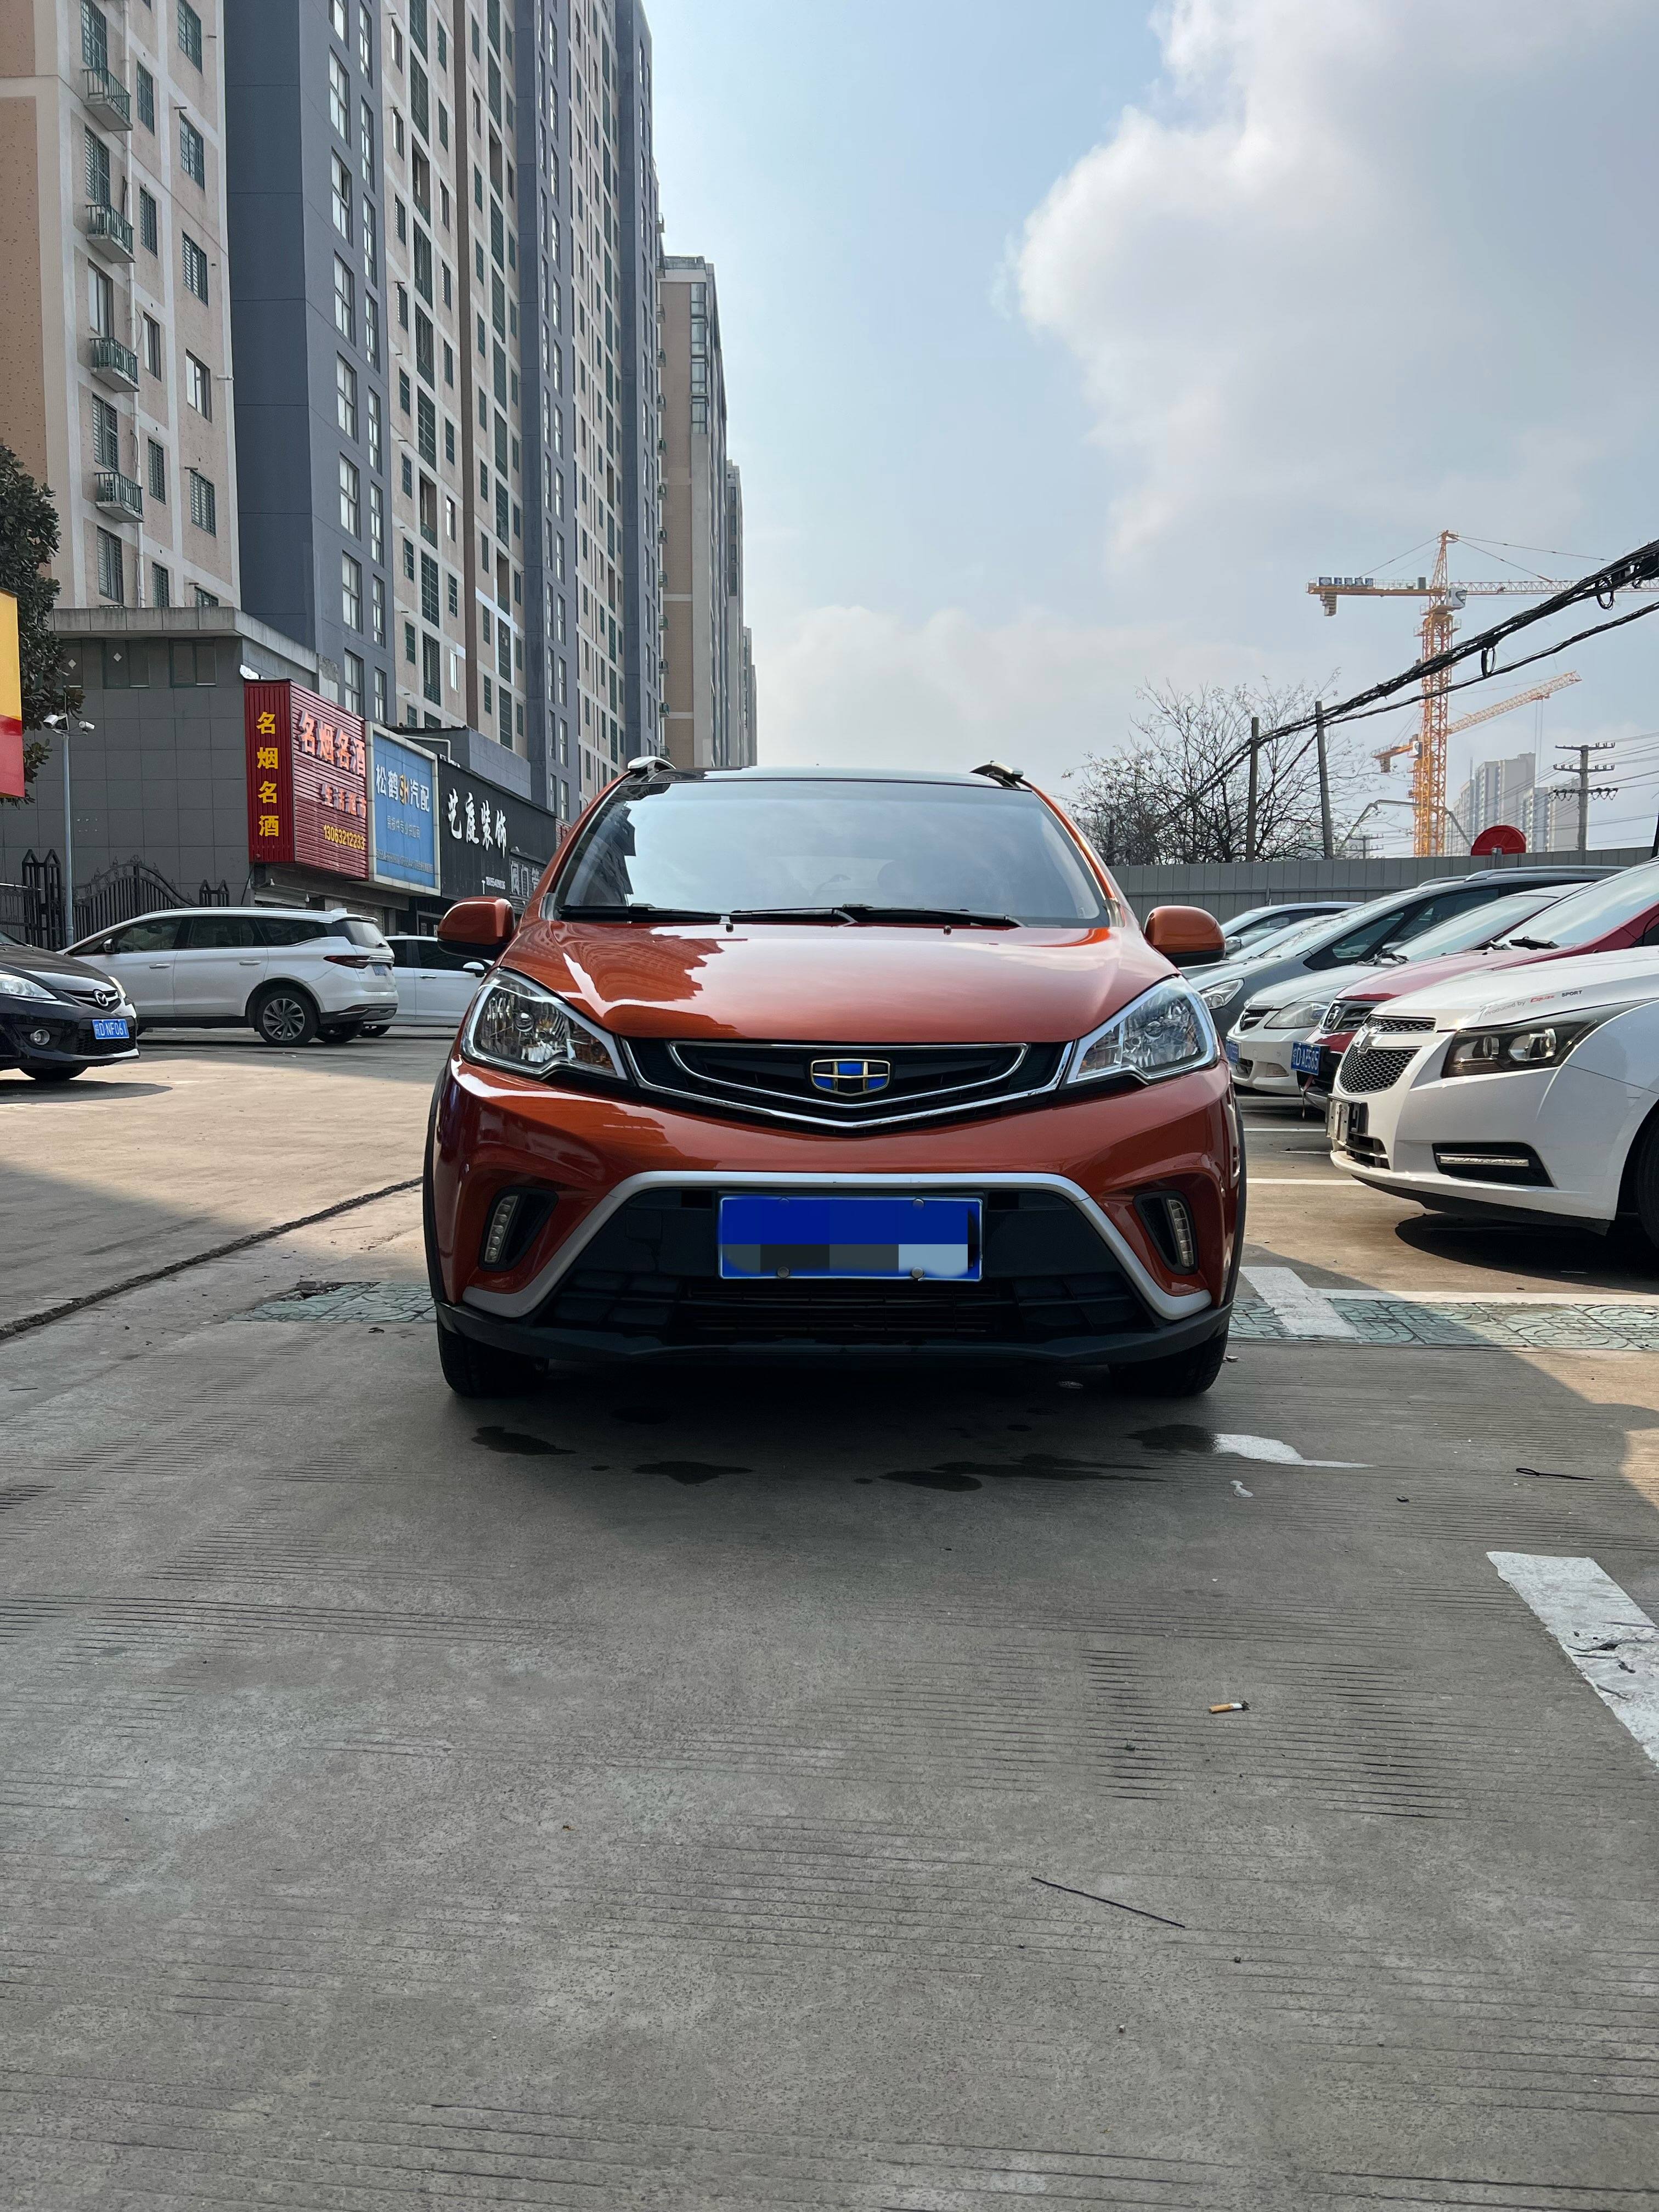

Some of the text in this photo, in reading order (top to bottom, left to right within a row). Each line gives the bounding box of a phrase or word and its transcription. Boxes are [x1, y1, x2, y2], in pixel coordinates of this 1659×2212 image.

[298, 711, 366, 777] 名烟名酒
[257, 712, 279, 837] 名烟名酒
[321, 783, 366, 818] 生活超市
[324, 825, 365, 850] 13063212233
[1485, 1002, 1516, 1016] Produced
